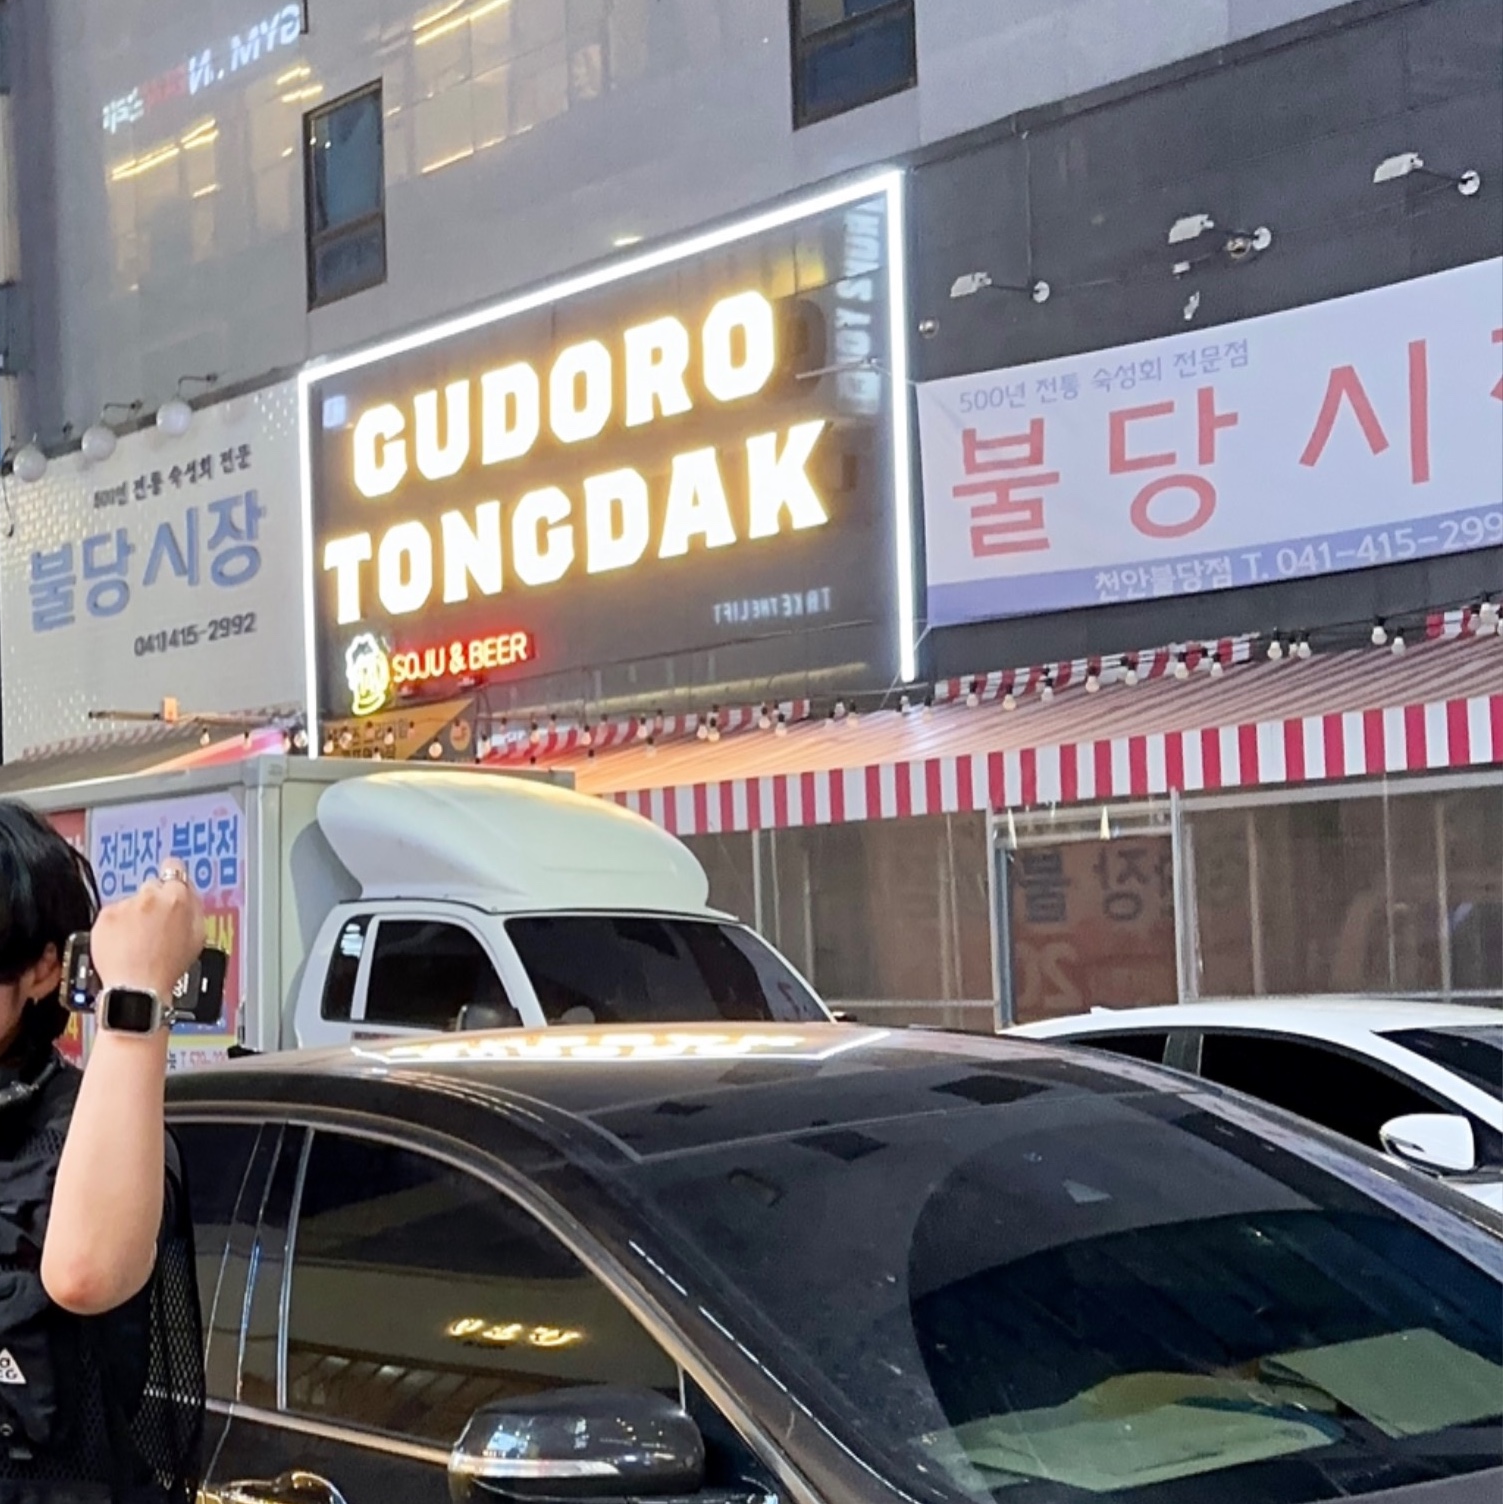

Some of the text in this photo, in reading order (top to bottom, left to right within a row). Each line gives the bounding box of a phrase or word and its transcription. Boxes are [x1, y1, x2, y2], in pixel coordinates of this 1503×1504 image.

[353, 289, 774, 498] GUDORO
[960, 338, 1249, 413] 500년 전통 숙성회 전문점
[168, 454, 214, 489] 숙성회
[323, 419, 829, 625] TONGDAK
[29, 489, 267, 633] 불당시장
[1094, 555, 1234, 602] 천안불당점
[1240, 551, 1270, 583] T.
[134, 612, 257, 657] 041)415-2992
[392, 631, 528, 684] SOJU & BEER
[99, 826, 163, 897] 정관장
